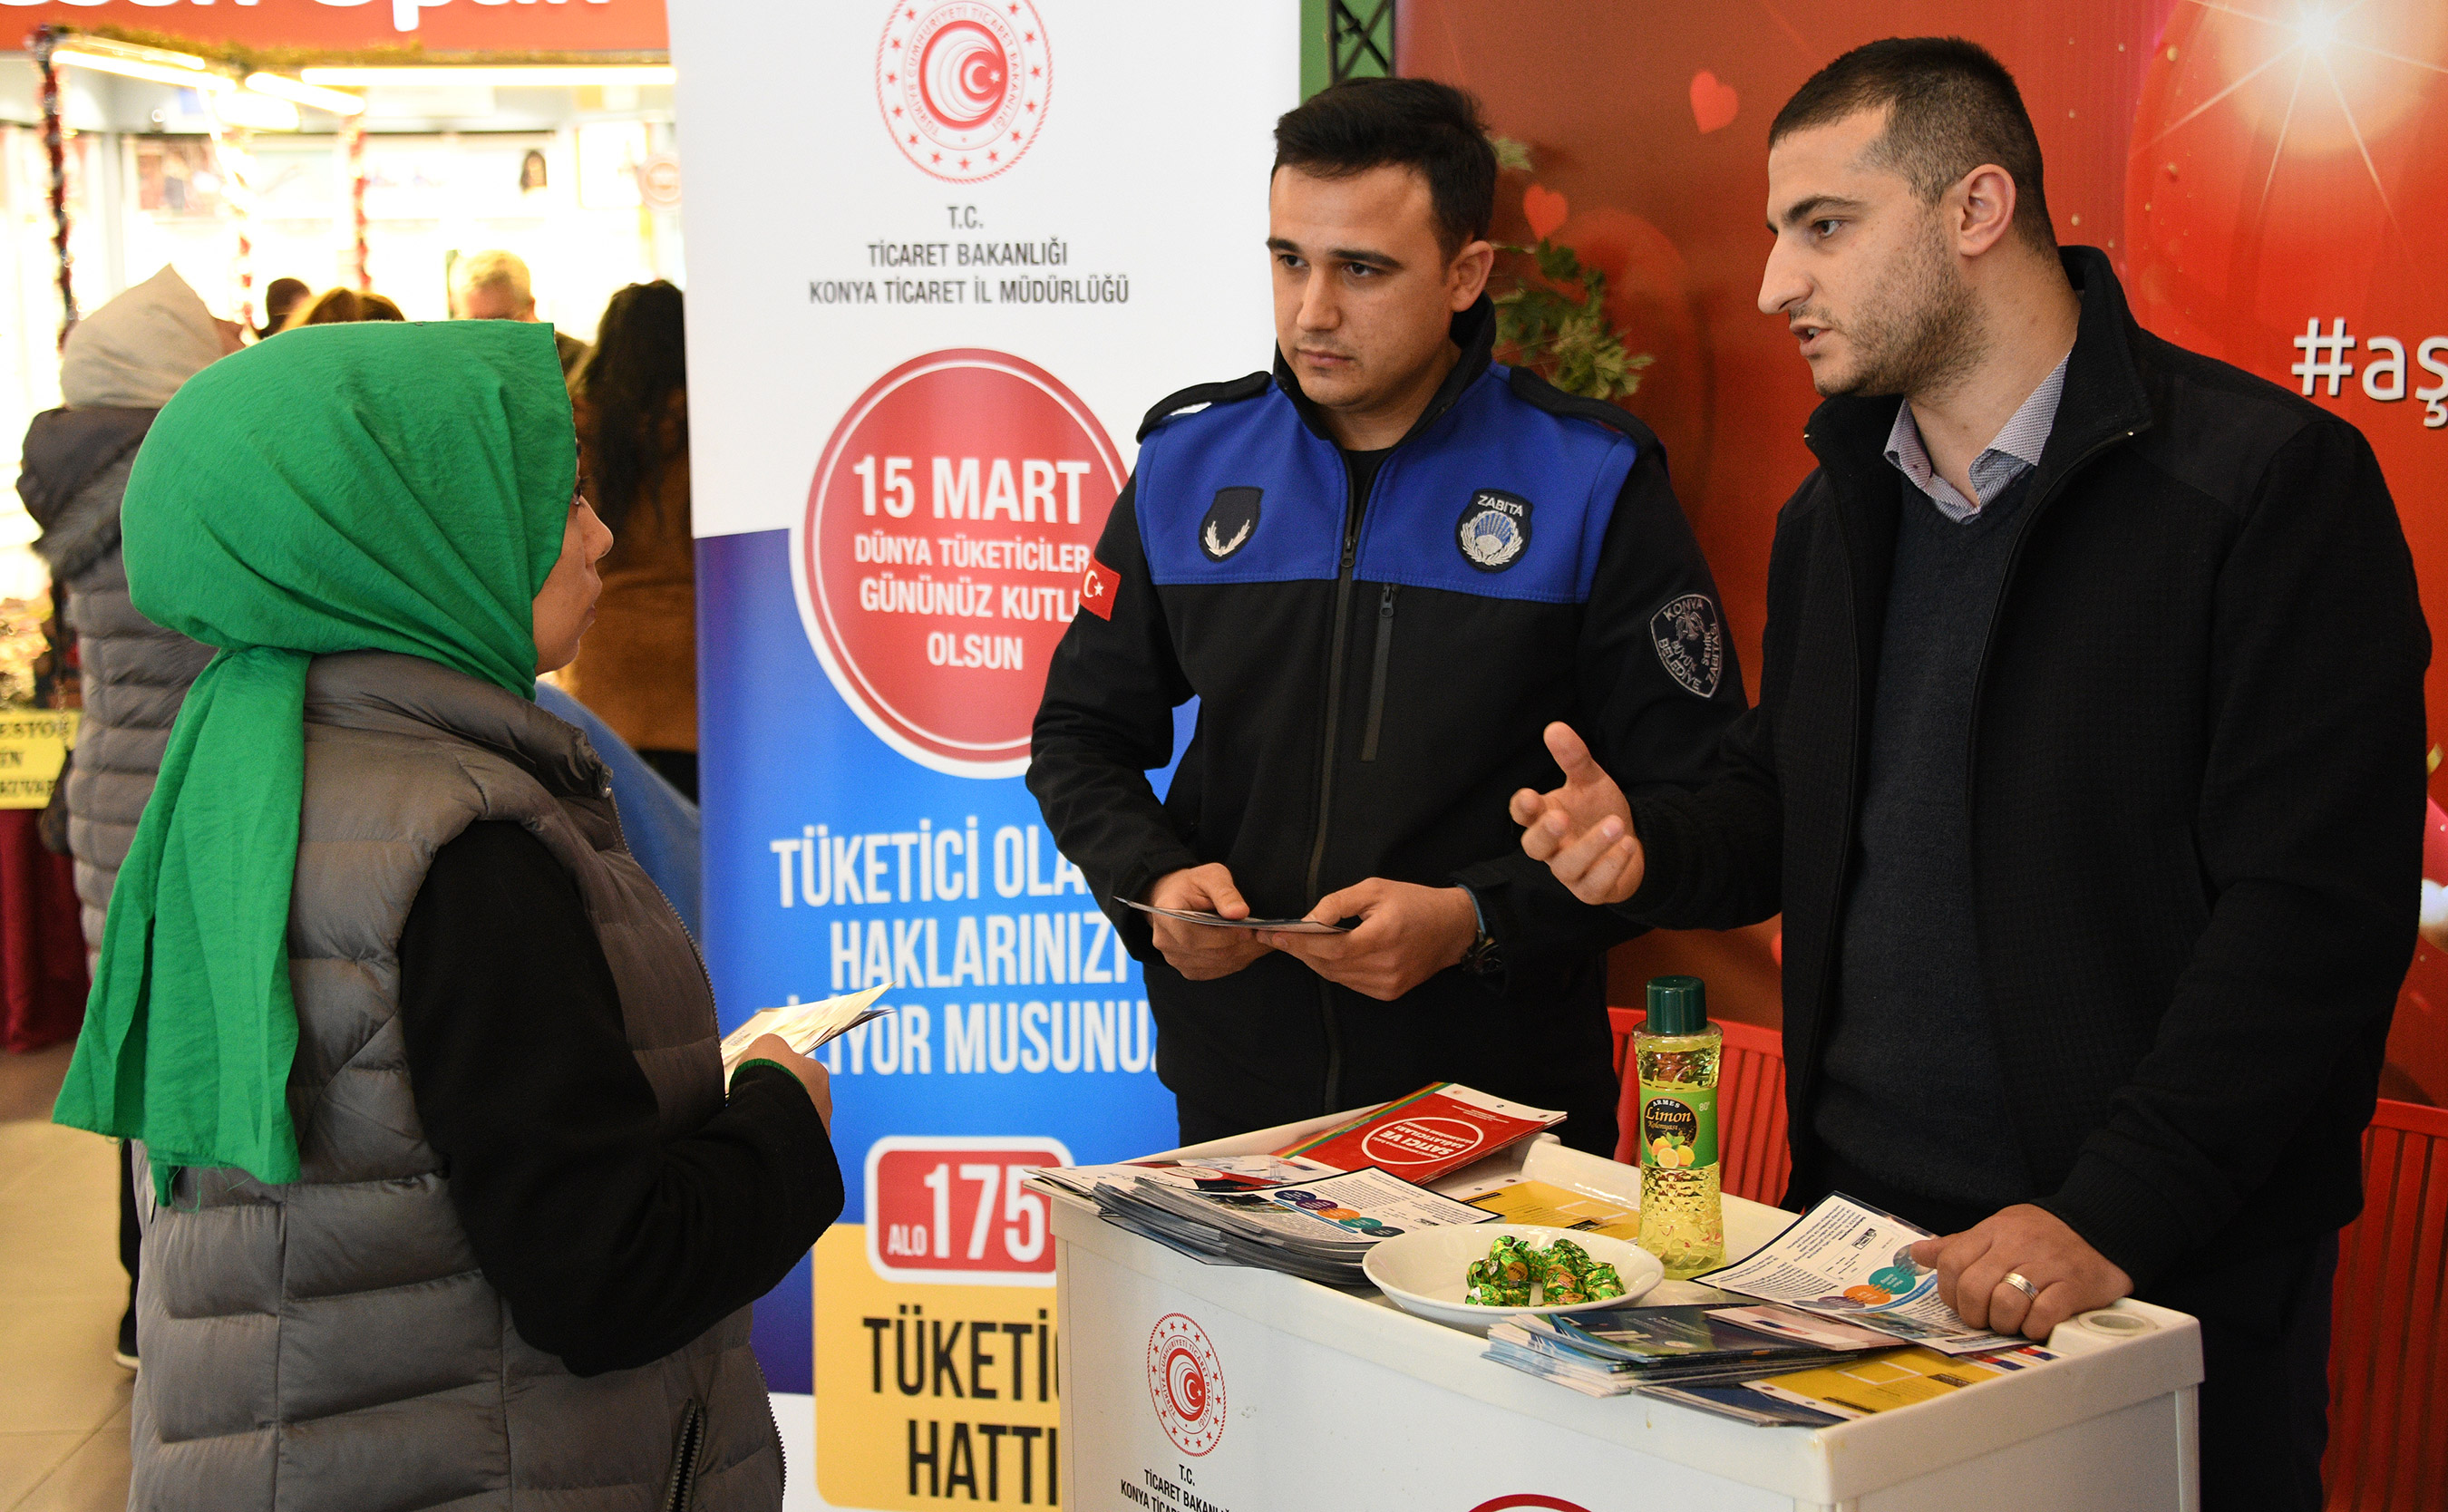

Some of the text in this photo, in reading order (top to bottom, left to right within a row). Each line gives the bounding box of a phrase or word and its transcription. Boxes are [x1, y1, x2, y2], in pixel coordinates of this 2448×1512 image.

[947, 205, 984, 229] T.C.
[868, 237, 1068, 267] TİCARET BAKANLIĞI
[810, 274, 1130, 305] KONYA TİCARET İL MÜDÜRLÜĞÜ
[2291, 316, 2448, 428] #aş
[852, 455, 1091, 525] 15 MART
[1477, 495, 1523, 517] ZABITA
[853, 529, 1090, 574] DÜNYA TÜKETİCİLER
[860, 571, 993, 618] GÜNÜNÜZ
[1663, 598, 1704, 621] KONYA
[927, 632, 1024, 671] OLSUN
[770, 815, 1093, 908] TÜKETİCİ OLA
[831, 911, 1128, 990] HAKLARINIZI
[944, 1000, 1157, 1074] MUSUNU
[1646, 1106, 1692, 1122] Limon
[1652, 1099, 1680, 1109] ARMES
[1379, 1129, 1454, 1155] SATICI VE
[888, 1163, 1045, 1263] ALO 175
[862, 1304, 1059, 1402] TÜKETİ
[1161, 1339, 1188, 1373] CUMHURİYETİ
[1190, 1343, 1208, 1377] TİCARET
[908, 1419, 1058, 1507] HATTI
[1179, 1463, 1196, 1487] T.C.
[1121, 1478, 1150, 1509] KONYA
[1144, 1468, 1180, 1502] TİCARET
